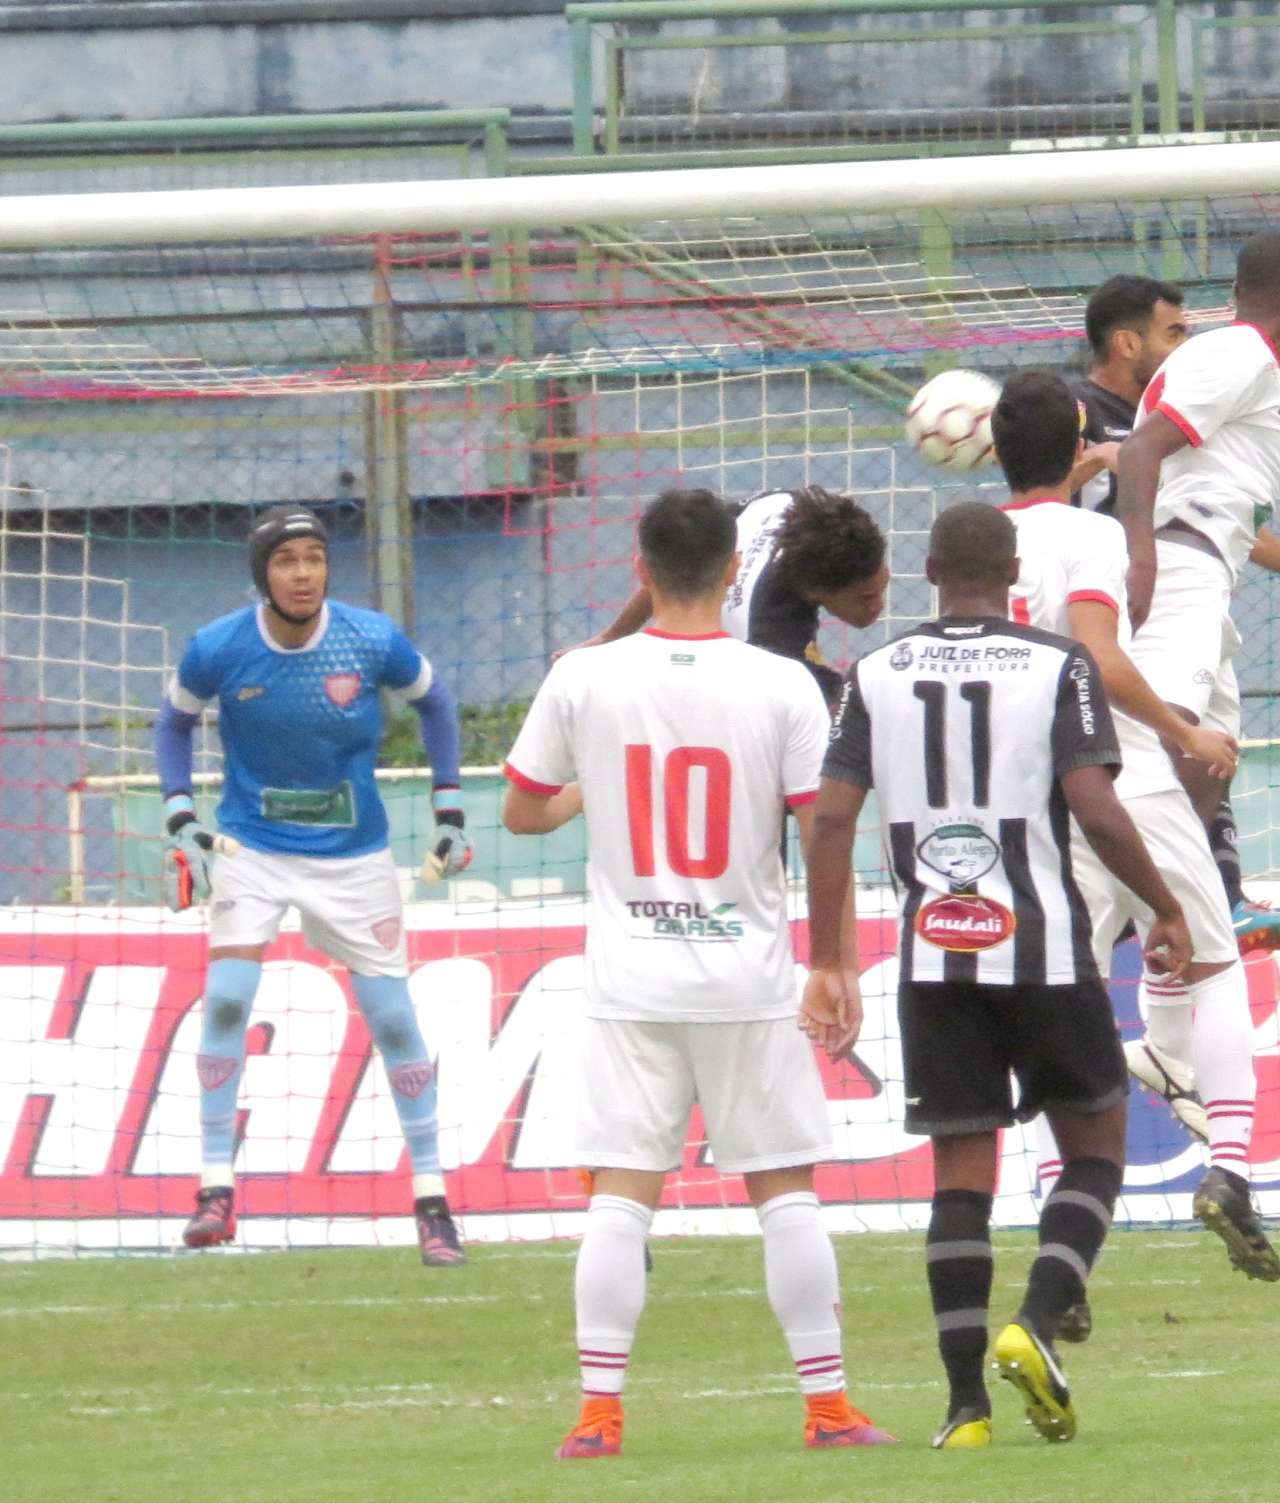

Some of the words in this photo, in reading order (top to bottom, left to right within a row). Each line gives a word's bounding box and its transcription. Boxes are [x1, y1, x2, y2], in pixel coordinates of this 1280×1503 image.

[920, 646, 956, 660] JUIZ
[960, 649, 980, 660] DE
[984, 647, 1031, 660] FORA
[918, 662, 1031, 673] PREFEITURA
[913, 680, 993, 809] 11
[625, 744, 732, 880] 10
[626, 901, 709, 919] TOTAL
